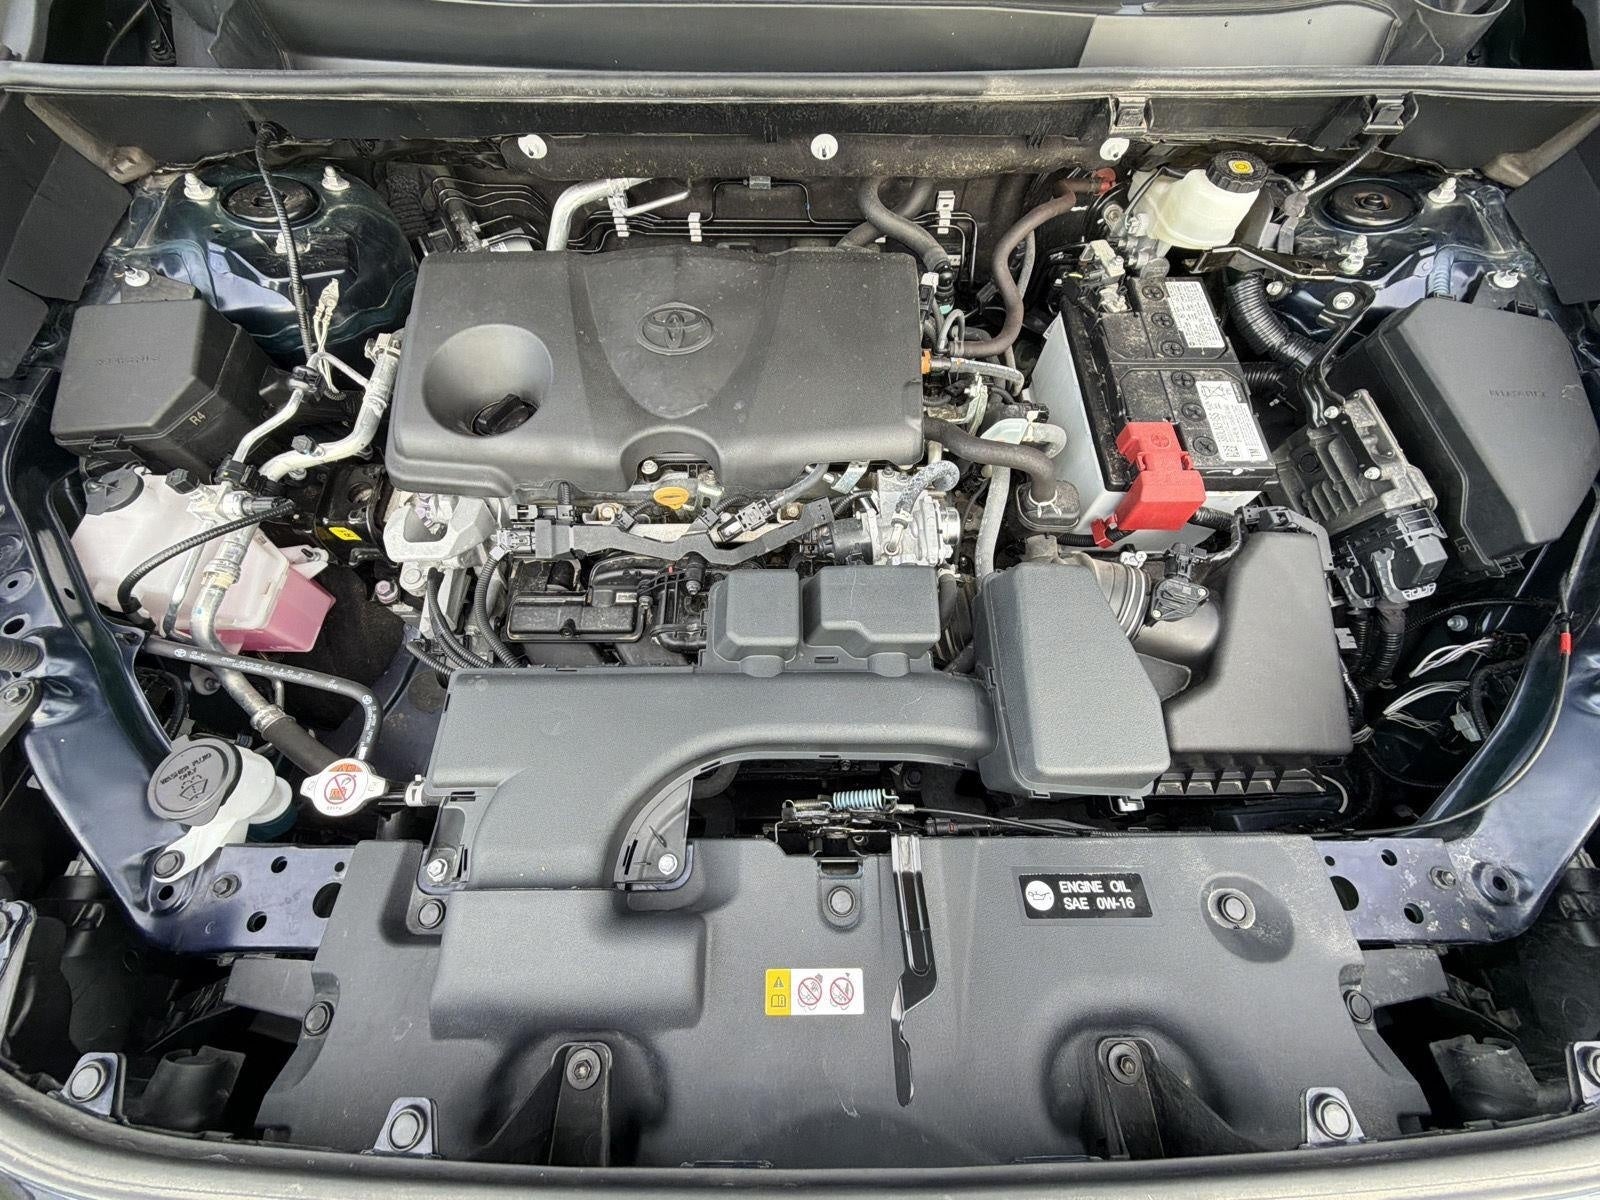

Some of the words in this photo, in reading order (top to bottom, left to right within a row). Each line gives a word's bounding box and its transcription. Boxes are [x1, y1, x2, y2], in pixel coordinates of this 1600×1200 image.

[188, 411, 206, 426] R4
[1058, 880, 1104, 893] ENGINE
[1109, 880, 1131, 893] OIL
[1063, 896, 1090, 910] SAE
[1096, 896, 1136, 910] 0W-16
